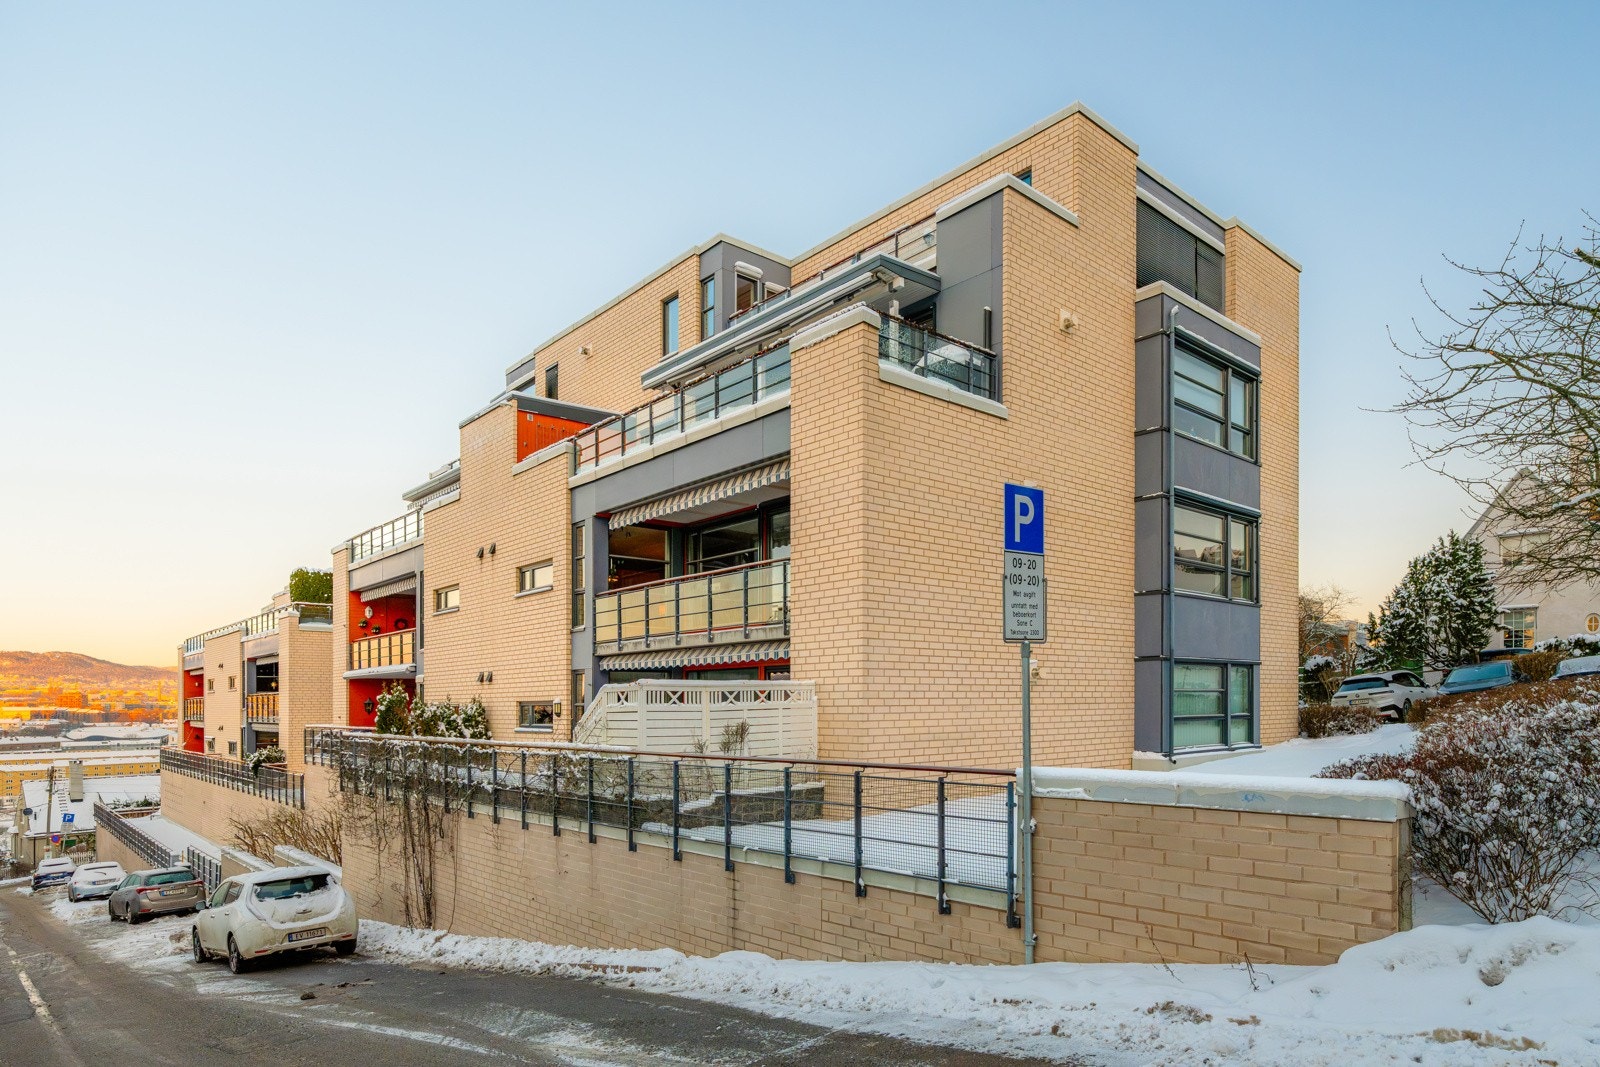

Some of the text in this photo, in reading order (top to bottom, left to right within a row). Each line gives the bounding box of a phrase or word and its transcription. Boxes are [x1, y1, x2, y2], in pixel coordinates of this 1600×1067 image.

[1015, 494, 1034, 542] P
[1012, 557, 1037, 570] 09-20
[1009, 573, 1040, 587] (09-20)
[1023, 591, 1036, 599] avgift
[1012, 610, 1037, 619] beboerkort
[1016, 619, 1033, 627] Sone C
